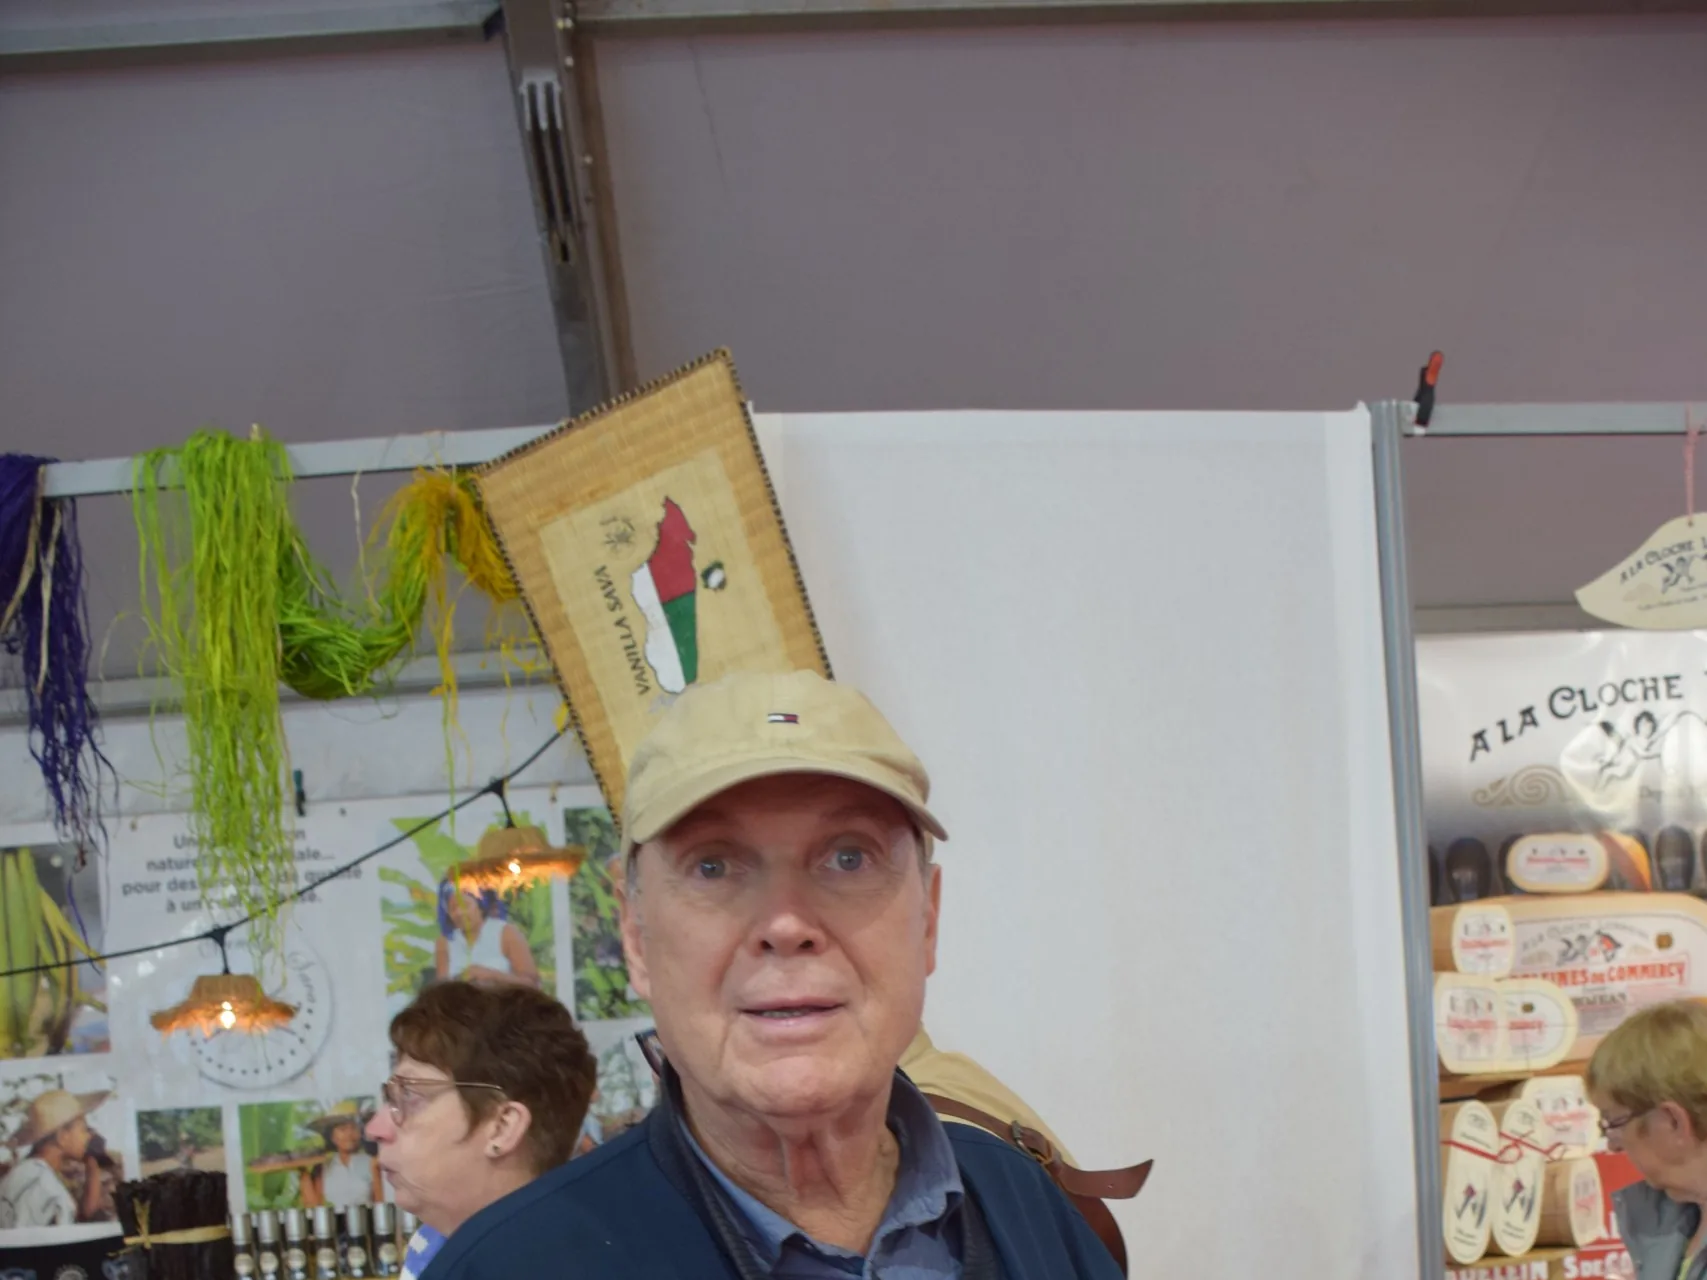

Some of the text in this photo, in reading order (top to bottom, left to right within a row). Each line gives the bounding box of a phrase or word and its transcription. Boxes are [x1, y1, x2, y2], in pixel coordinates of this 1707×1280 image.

[593, 565, 651, 696] VANILLA SAVA
[1469, 674, 1684, 763] A LA CLOCHE
[121, 882, 161, 898] pour
[166, 876, 198, 892] des
